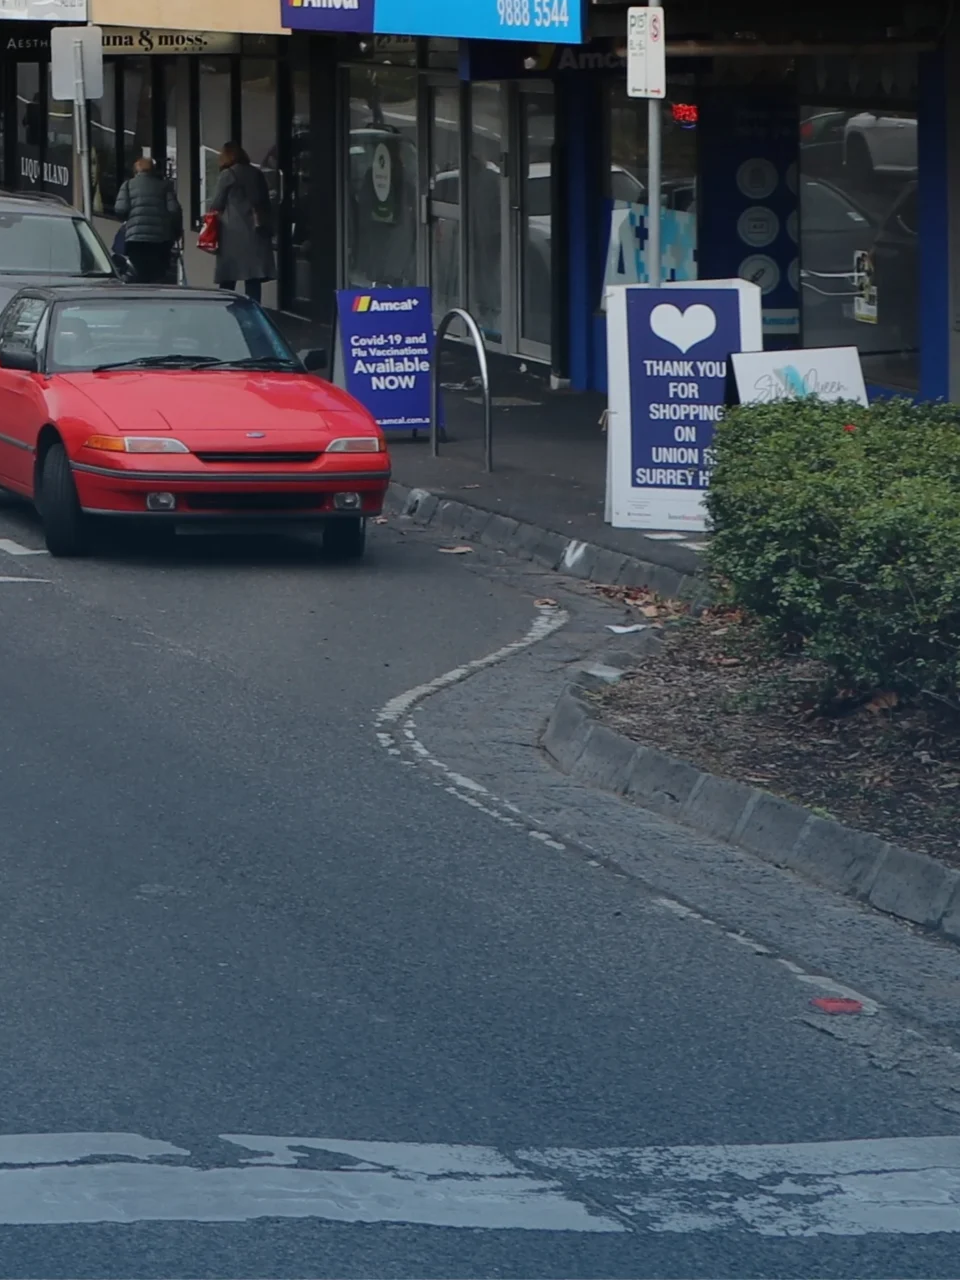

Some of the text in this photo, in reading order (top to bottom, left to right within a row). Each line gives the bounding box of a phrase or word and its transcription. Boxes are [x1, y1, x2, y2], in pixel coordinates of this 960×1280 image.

[6, 38, 51, 50] AESTH
[101, 34, 134, 47] una
[557, 47, 627, 70] Amc
[21, 156, 69, 187] LIQURLAND
[350, 333, 427, 346] Covid-19 and
[351, 347, 428, 357] Flu Vaccinations
[353, 357, 430, 374] Available
[644, 360, 727, 378] THANK YOU
[371, 375, 416, 391] NOW
[669, 382, 699, 399] FOR
[649, 403, 724, 421] SHOPPING
[674, 426, 696, 442] ON
[652, 447, 698, 464] UNION
[636, 468, 694, 486] SURREY
